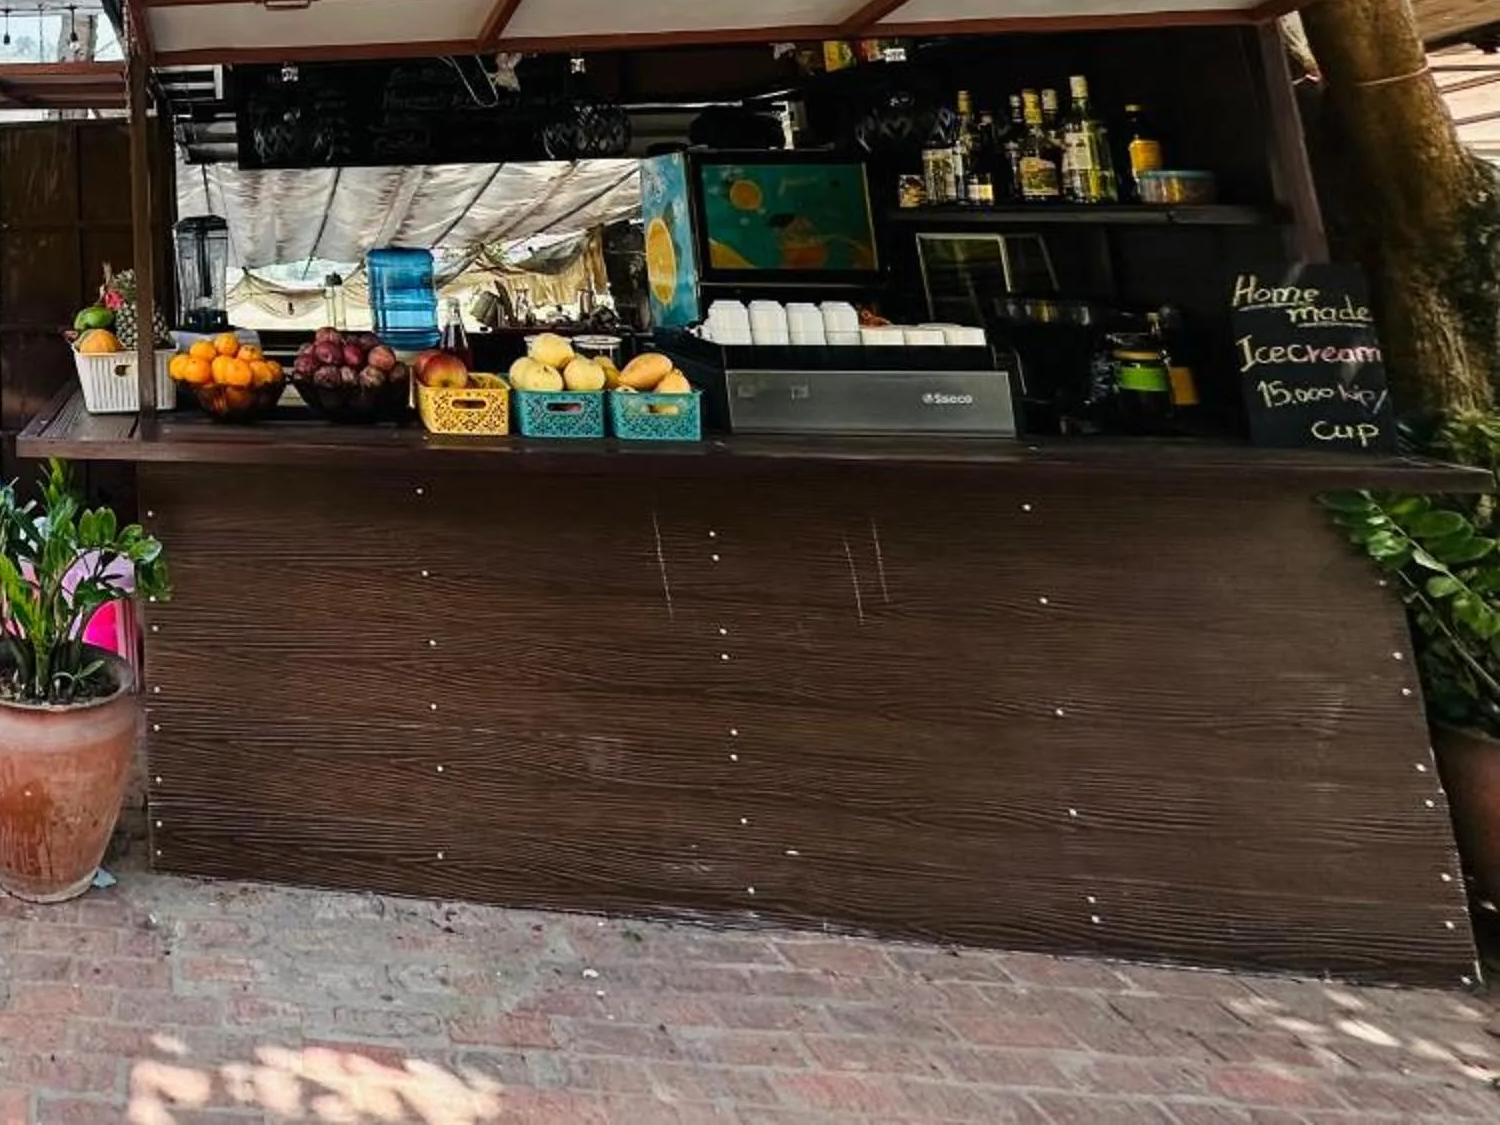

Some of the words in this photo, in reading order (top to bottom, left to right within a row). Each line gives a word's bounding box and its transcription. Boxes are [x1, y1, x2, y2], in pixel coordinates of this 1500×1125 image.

[1232, 274, 1320, 308] Home
[1285, 294, 1373, 324] made
[1257, 380, 1335, 408] 15.000
